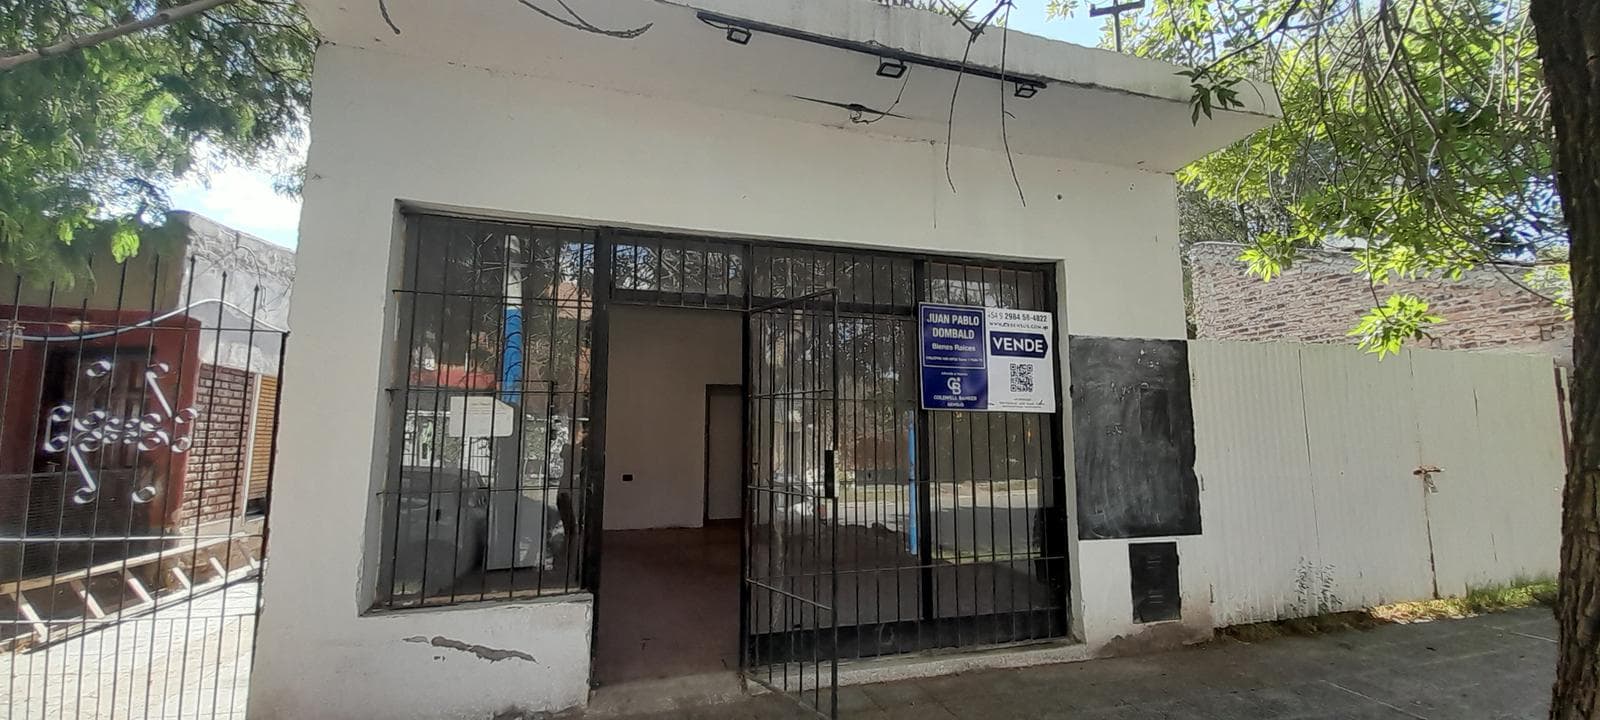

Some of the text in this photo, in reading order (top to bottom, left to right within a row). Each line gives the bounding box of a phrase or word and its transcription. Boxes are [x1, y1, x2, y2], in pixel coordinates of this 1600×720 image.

[926, 313, 980, 326] JUAN PABLO
[932, 327, 975, 340] DOMBALD
[992, 337, 1044, 353] VENDE
